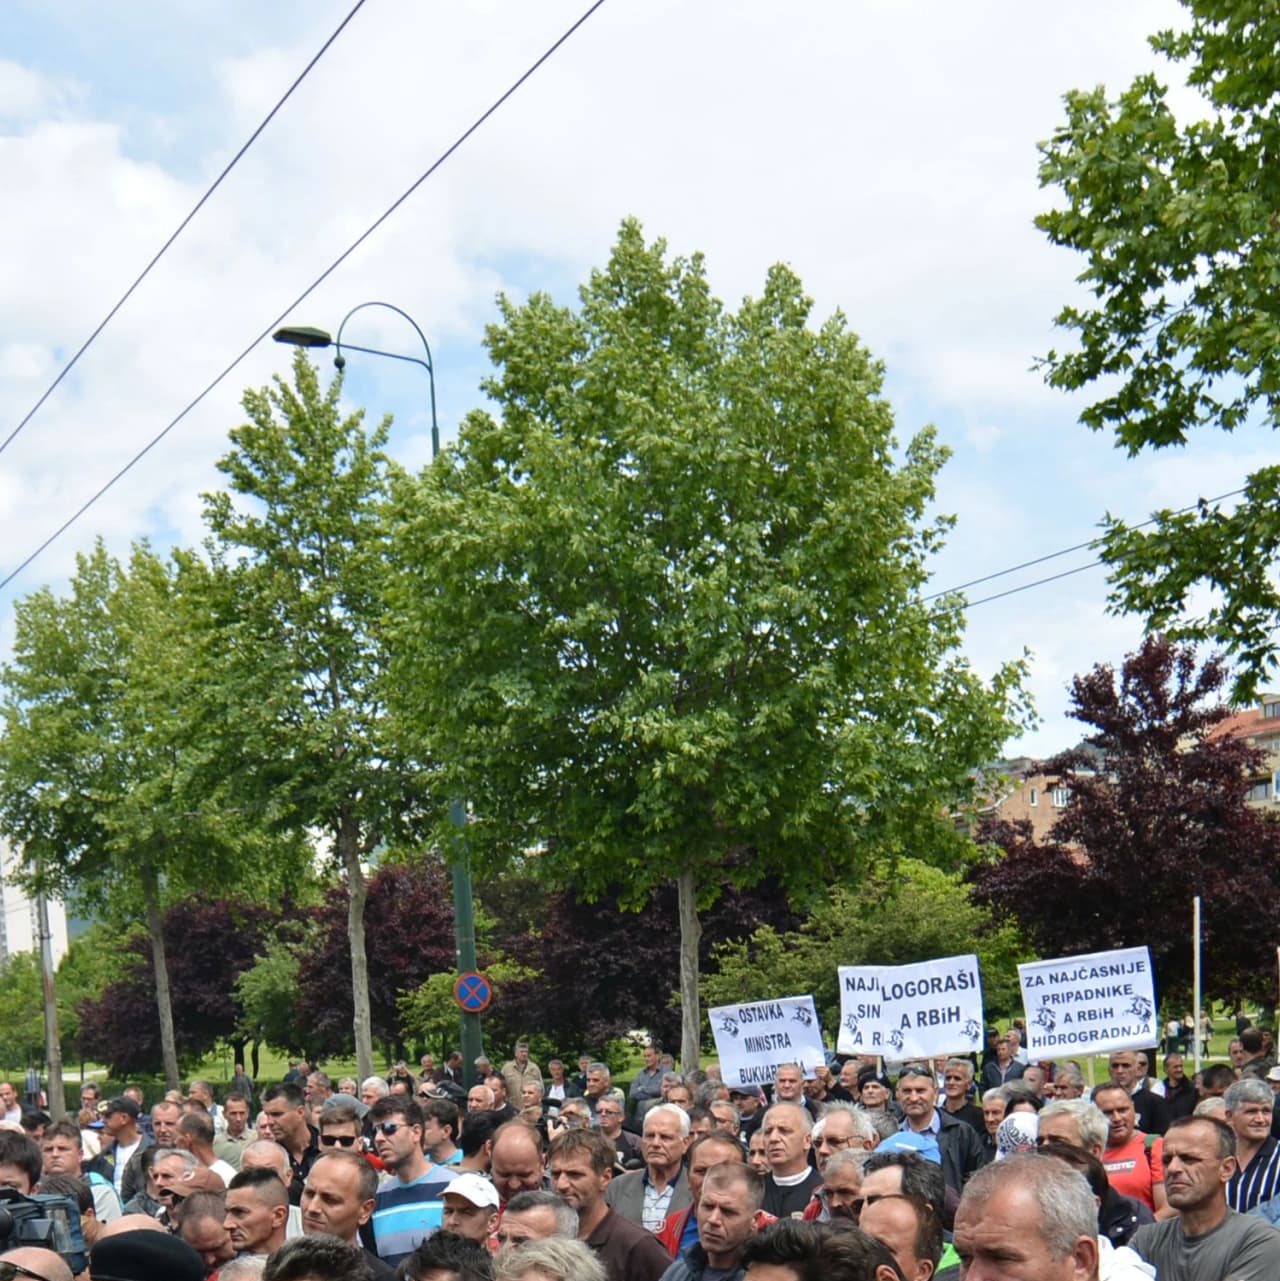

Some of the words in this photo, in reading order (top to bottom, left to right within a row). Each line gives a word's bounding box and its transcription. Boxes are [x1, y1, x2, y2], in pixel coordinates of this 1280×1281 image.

[881, 969, 976, 1001] LOGORAŠI
[1025, 976, 1045, 988] ZA
[1049, 961, 1146, 984] NAJČASNIJE
[1041, 984, 1134, 1006] PRIPADNIKE
[738, 1003, 784, 1024] OSTAVKA
[900, 1013, 911, 1030] A
[916, 1005, 960, 1028] RBiH
[1063, 1013, 1073, 1024] A
[1077, 1008, 1115, 1022] RBiH
[744, 1032, 792, 1053] MINISTRA
[853, 1031, 863, 1046] A
[1032, 1023, 1151, 1048] HIDROGRADNJA
